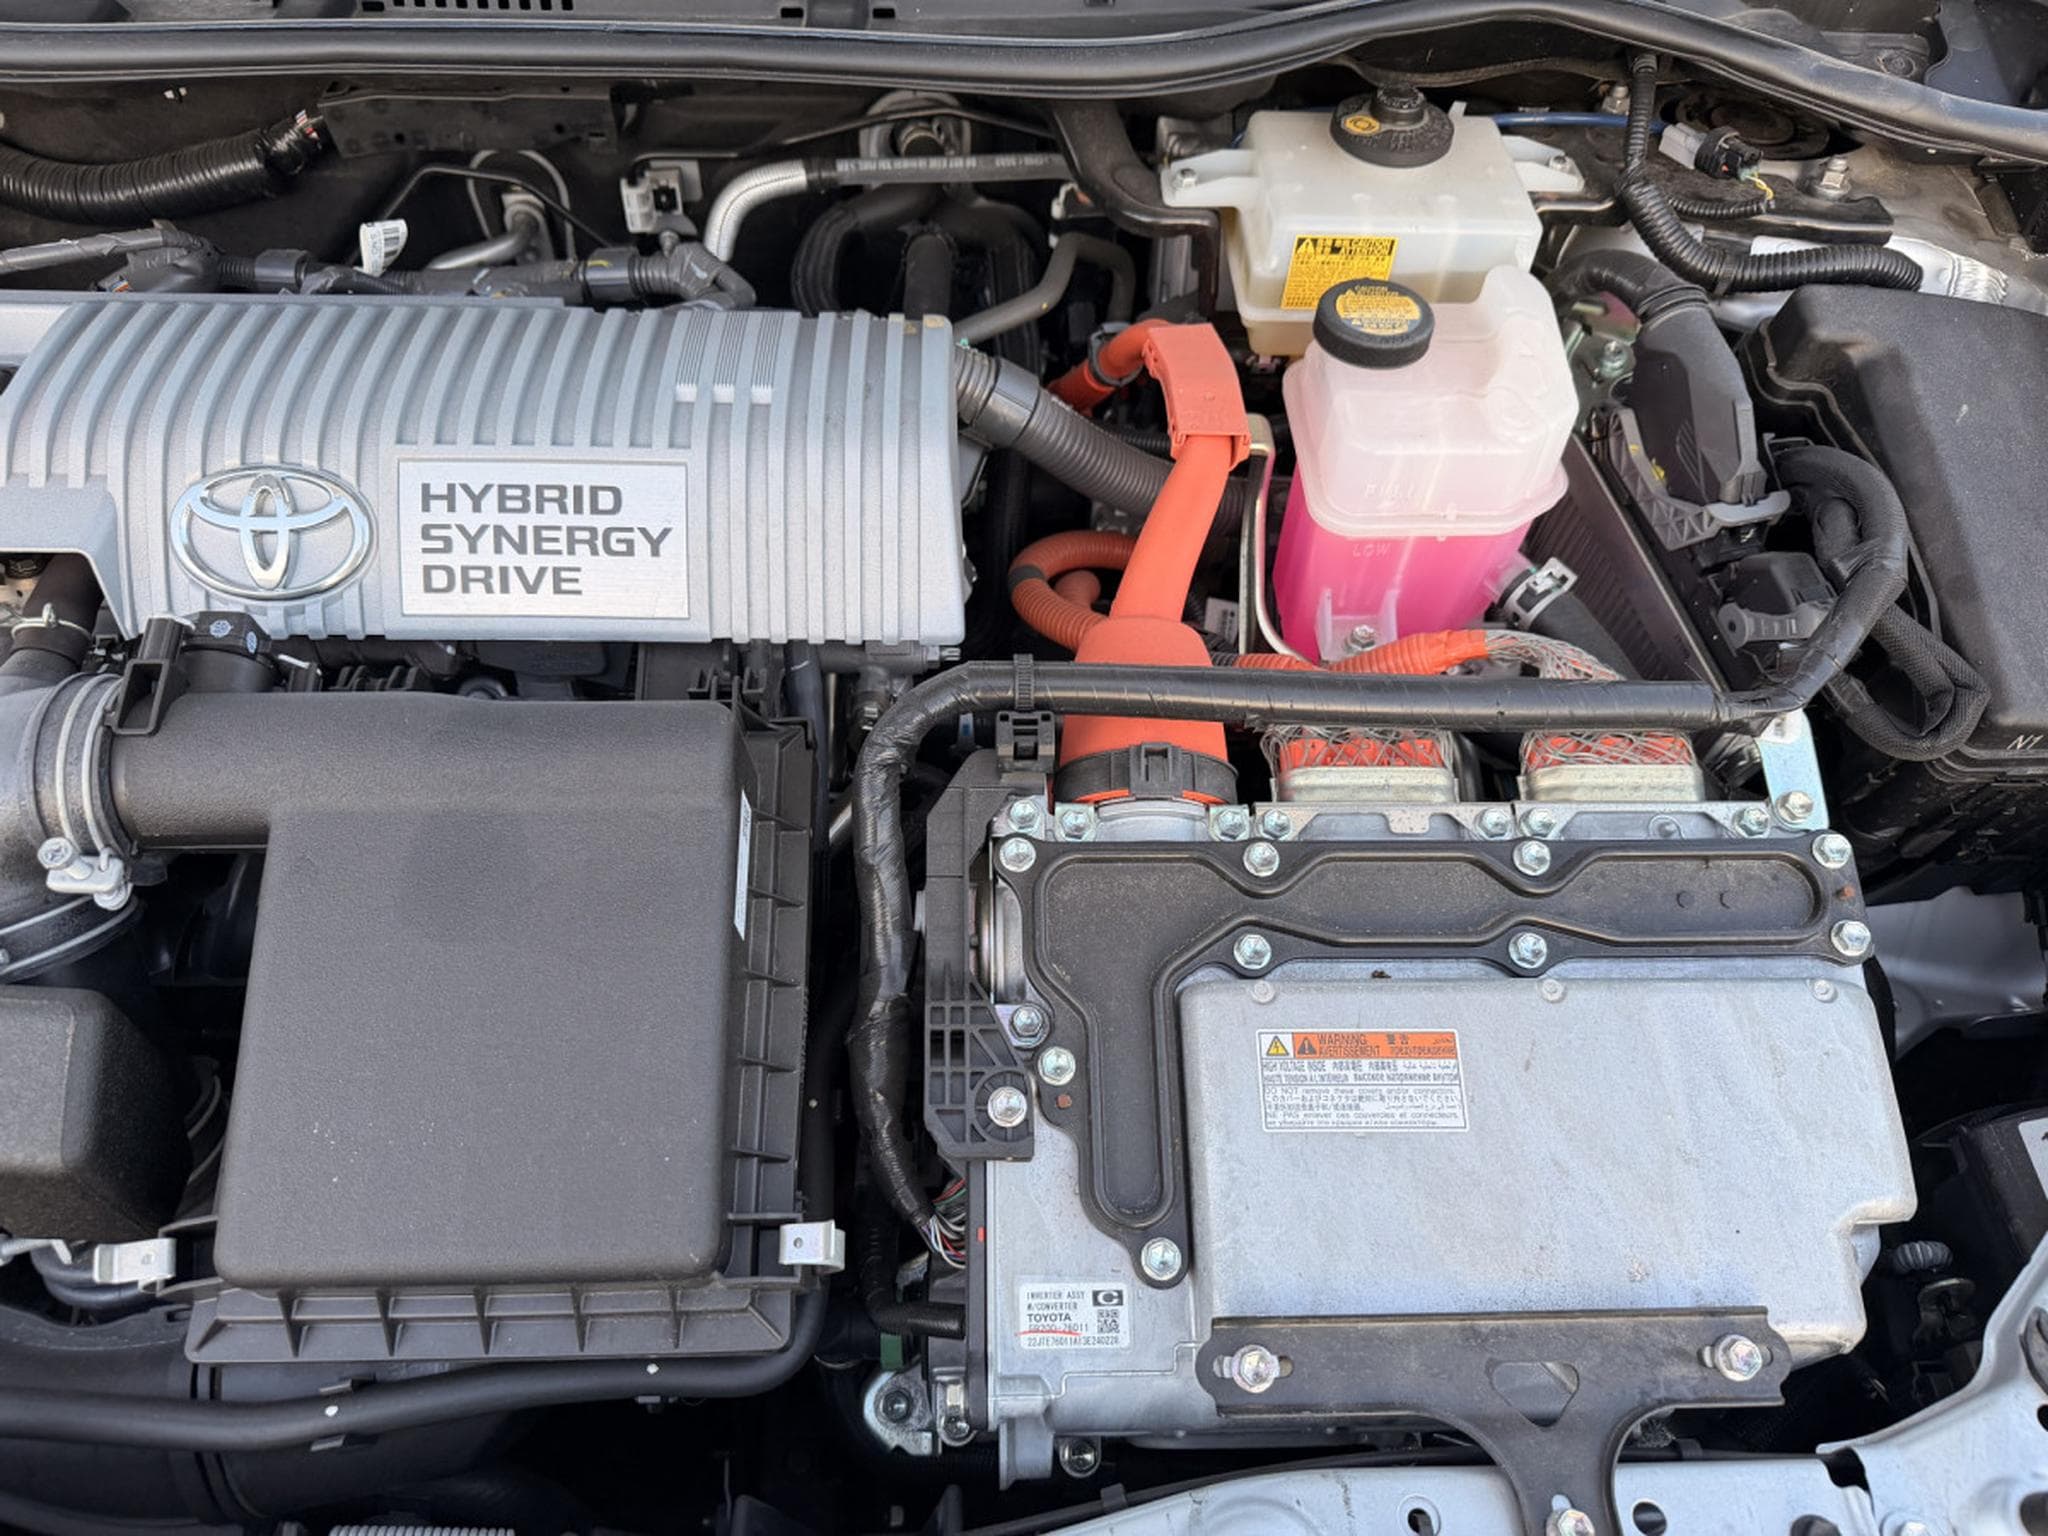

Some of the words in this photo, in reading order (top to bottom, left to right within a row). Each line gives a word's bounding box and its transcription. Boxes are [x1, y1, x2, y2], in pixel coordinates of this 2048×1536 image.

[421, 482, 623, 516] HYBRID
[421, 523, 673, 557] SYNERGY
[1352, 543, 1391, 558] LOW
[422, 564, 583, 595] DRIVE
[1317, 1033, 1367, 1045] WARNING
[1281, 1087, 1298, 1095] NOT
[1027, 1290, 1062, 1300] INVERTER
[1066, 1290, 1085, 1299] ASSY
[1027, 1313, 1072, 1323] TOYOTA
